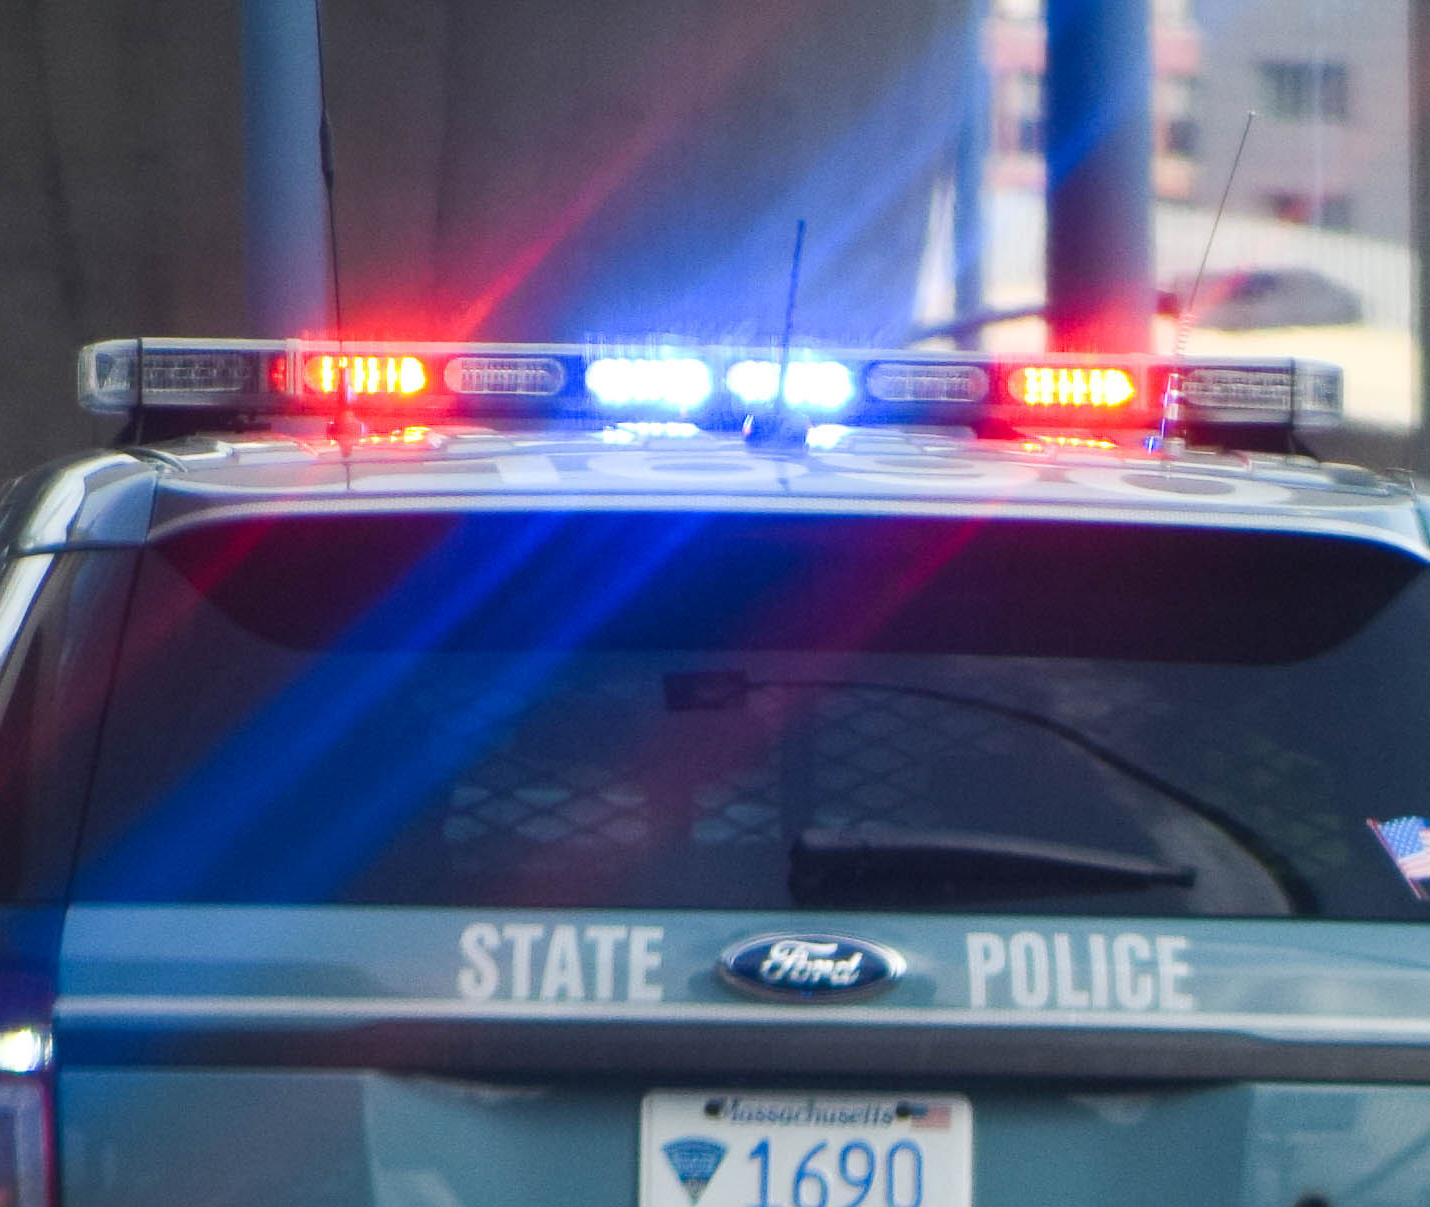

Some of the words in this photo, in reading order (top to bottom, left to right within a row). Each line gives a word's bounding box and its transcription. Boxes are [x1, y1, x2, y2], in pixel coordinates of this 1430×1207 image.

[458, 922, 664, 1001] STATE
[760, 938, 863, 985] Ford
[966, 931, 1195, 1011] POLICE
[722, 1100, 895, 1127] Massachusetts
